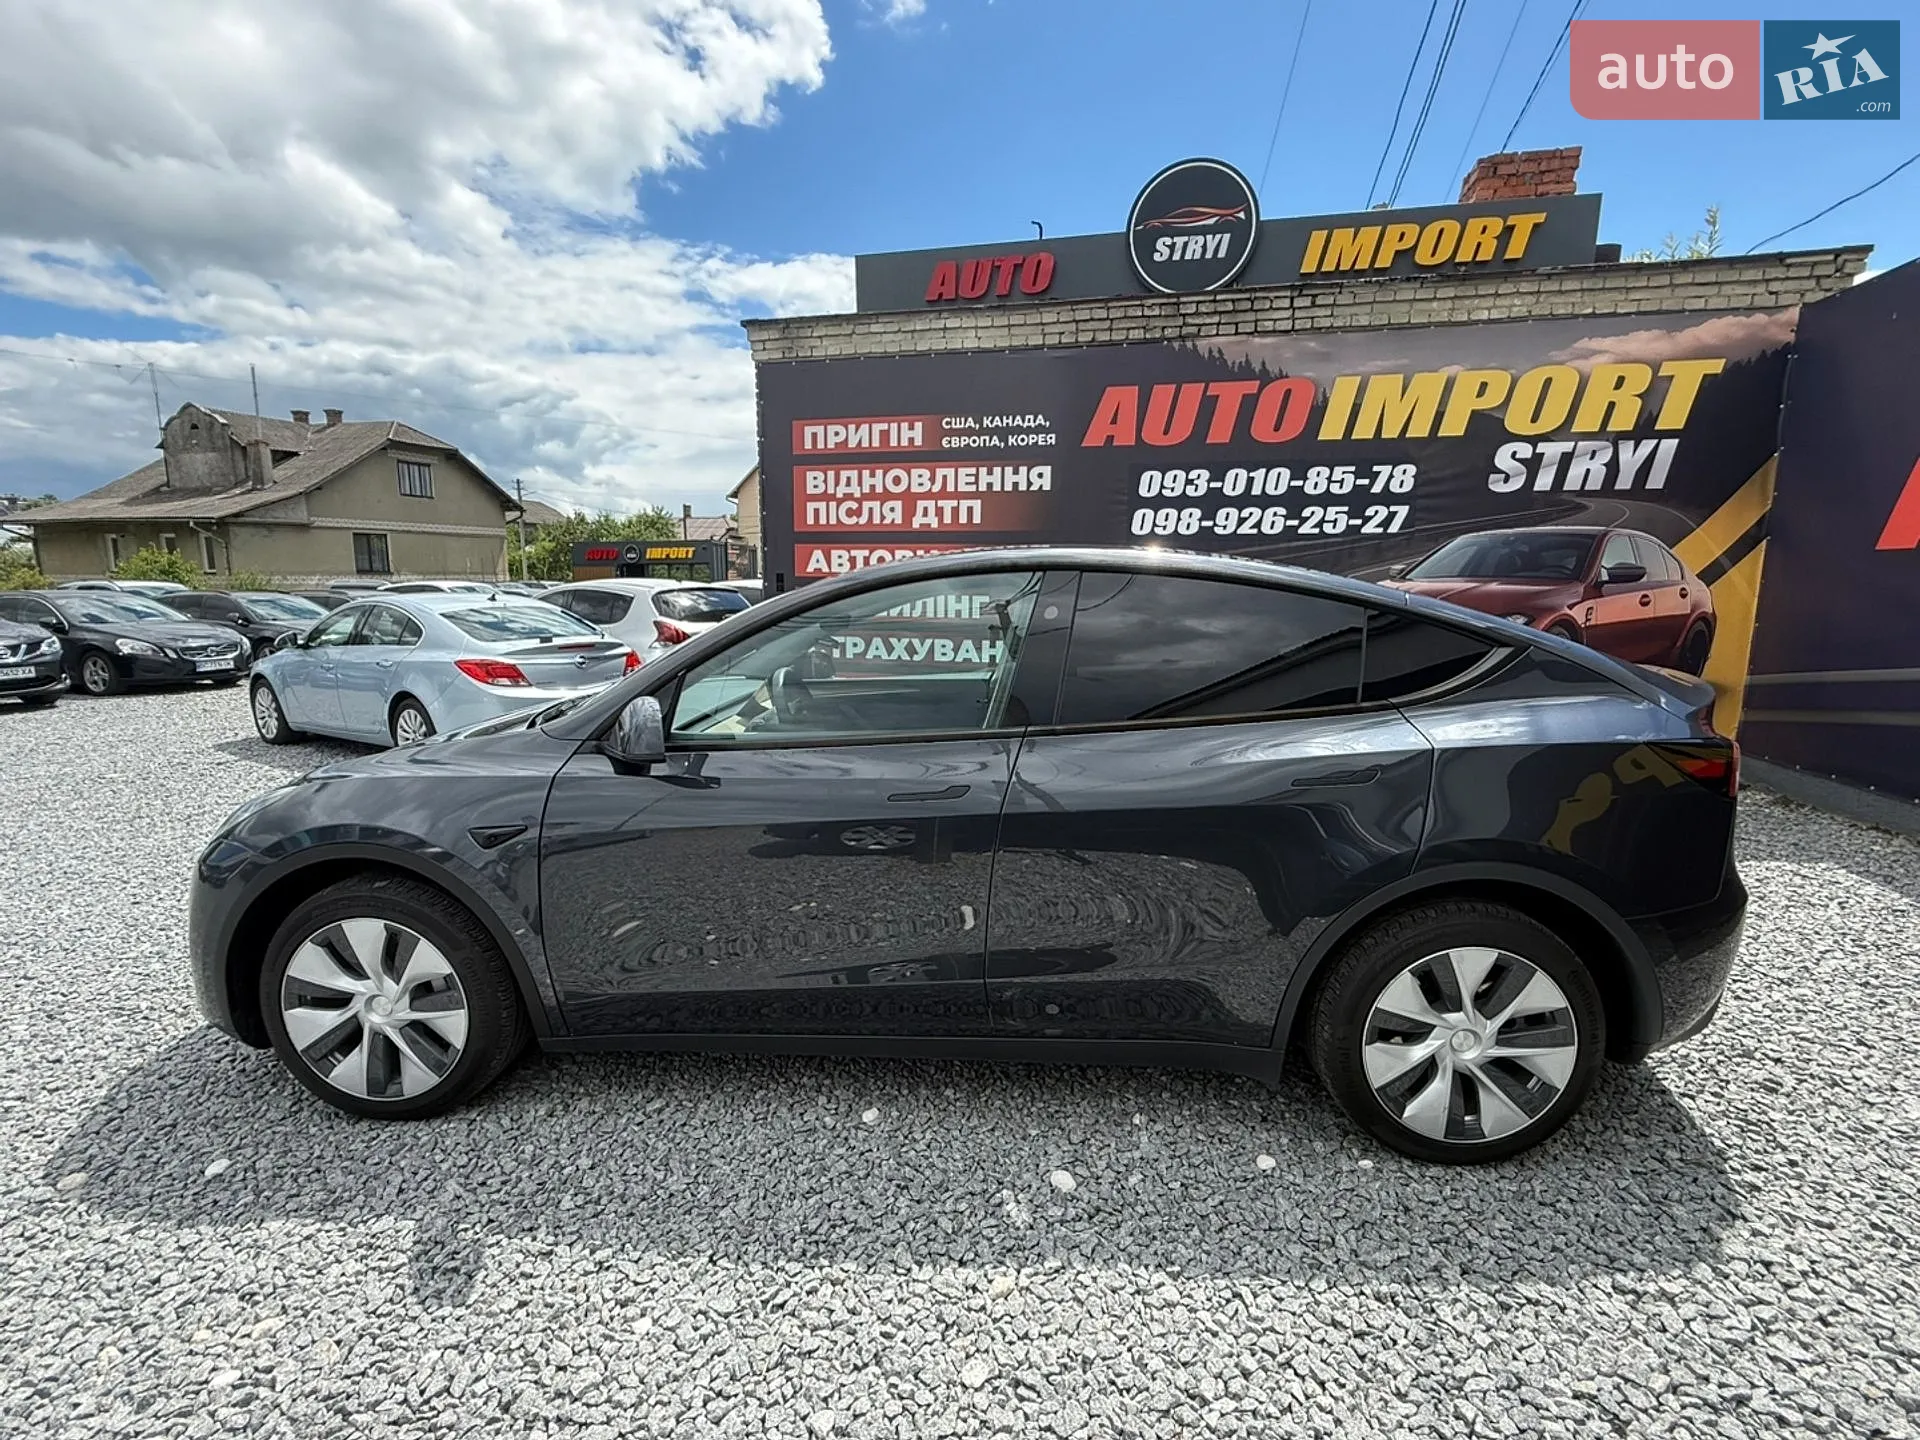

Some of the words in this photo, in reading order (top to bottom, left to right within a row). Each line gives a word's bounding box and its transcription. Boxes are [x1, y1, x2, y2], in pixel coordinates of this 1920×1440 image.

[925, 251, 1054, 301] AUTO
[1152, 232, 1231, 263] STRYI
[1300, 212, 1547, 274] IMPORT
[803, 421, 923, 450] ПРИГІН
[941, 417, 979, 430] США,
[982, 414, 1050, 428] КАНАДА,
[941, 435, 1004, 448] ЄВРОПА,
[1008, 433, 1056, 446] КОРЕЯ
[1138, 463, 1417, 498] 093-010-85-78
[1488, 438, 1680, 493] STRYI
[805, 465, 1052, 498] ВІДНОВЛЕННЯ
[805, 500, 903, 525] ПІСЛЯ
[911, 499, 982, 529] ДТП
[1131, 505, 1411, 536] 098-926-25-27
[584, 547, 620, 561] AUTO
[645, 546, 696, 560] IMPORT
